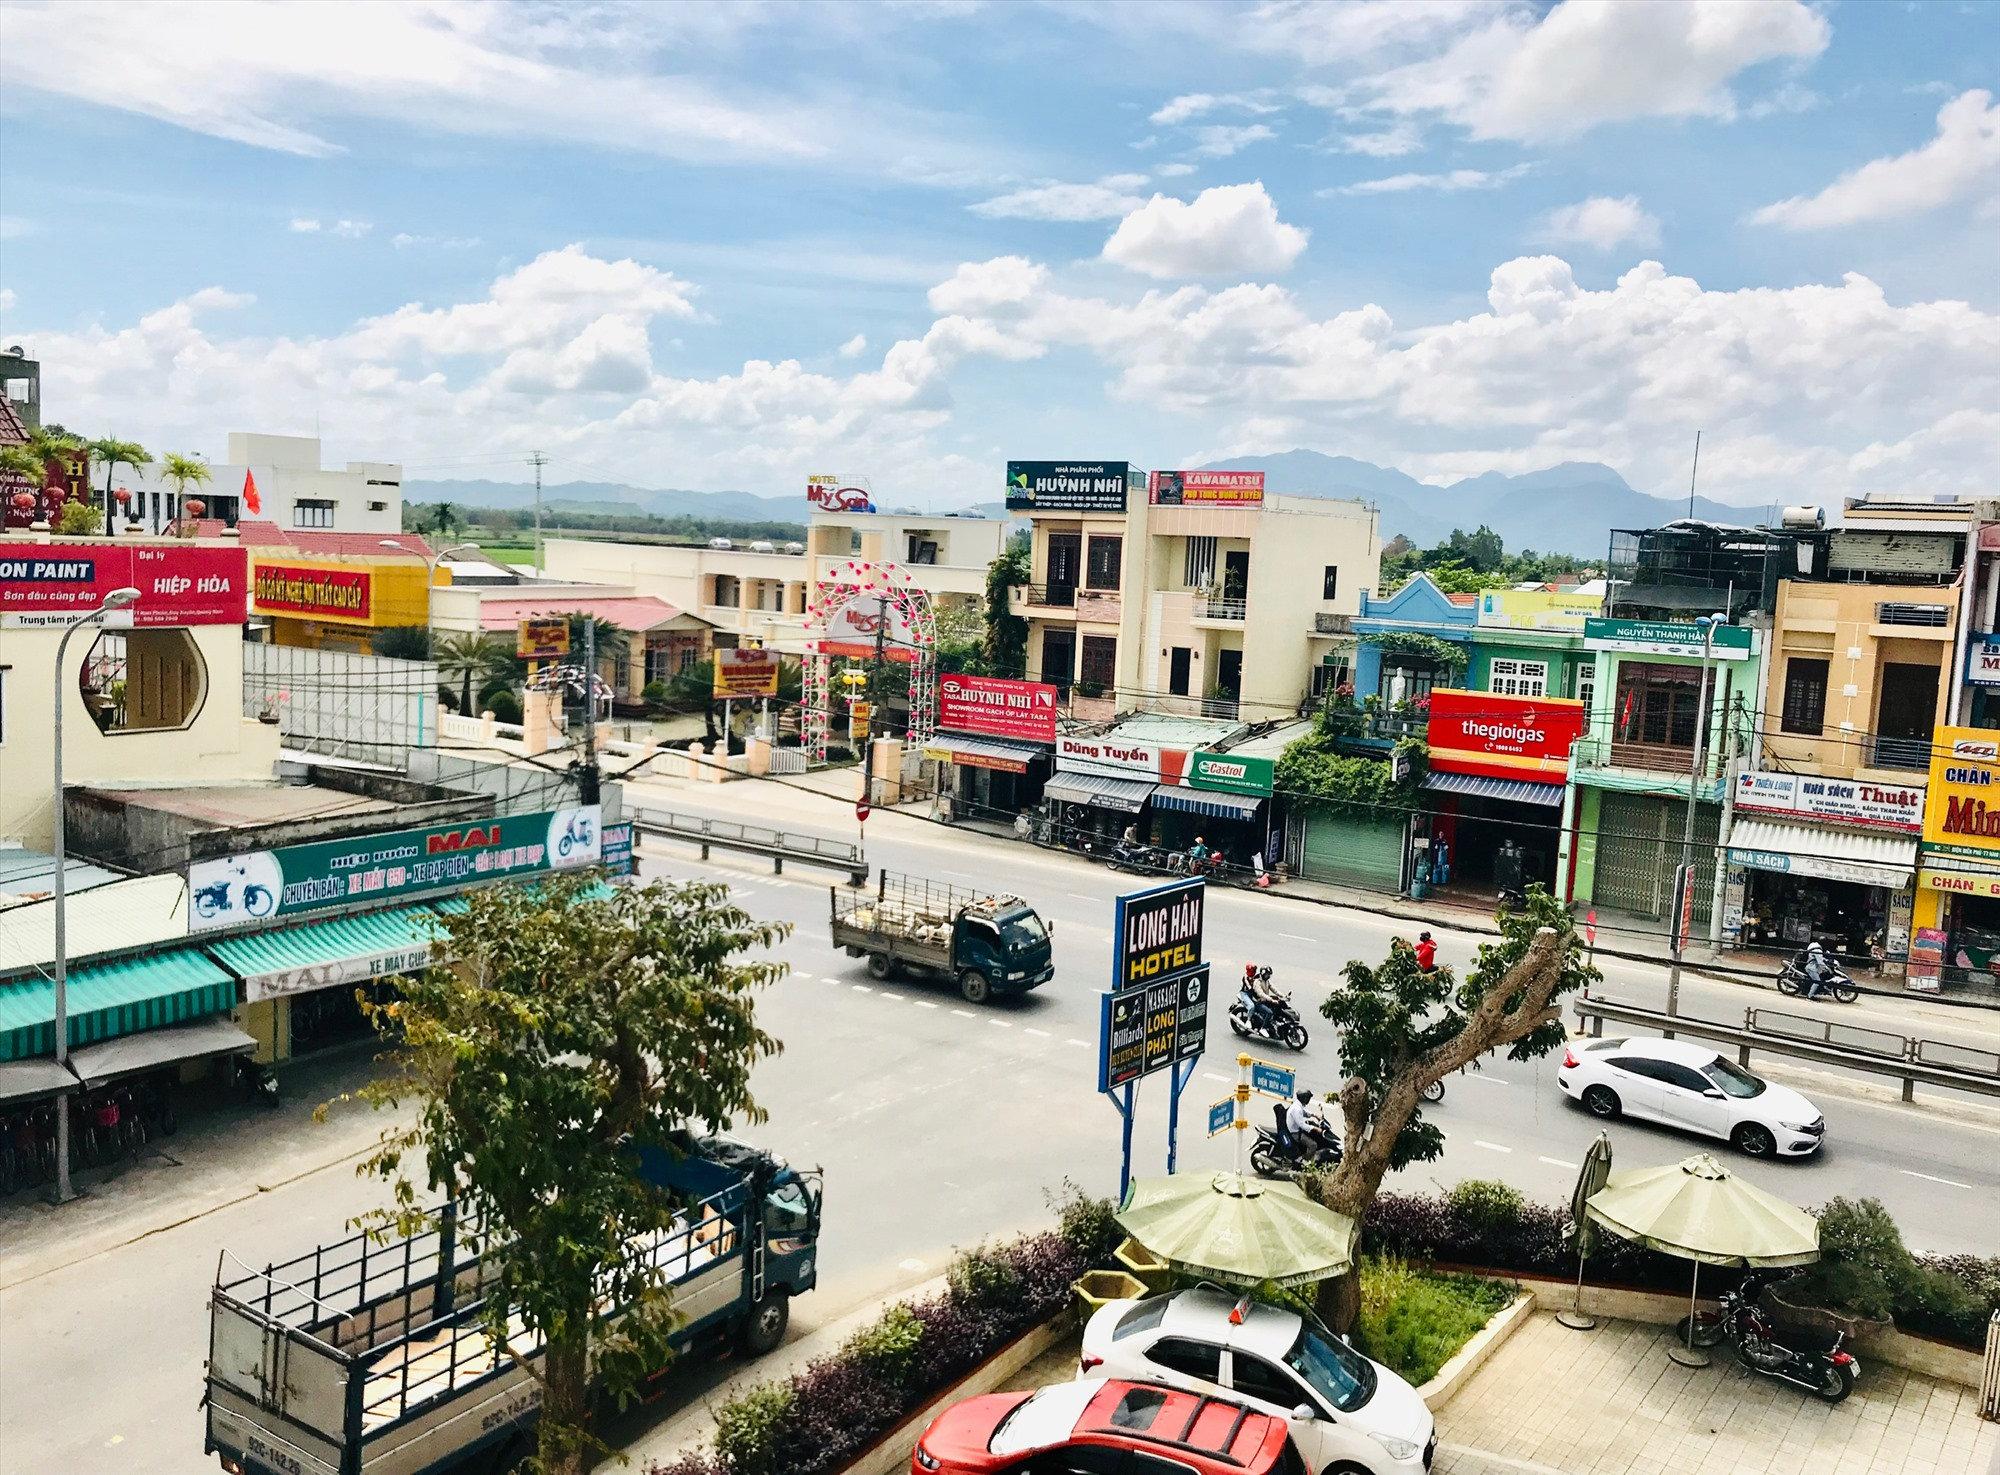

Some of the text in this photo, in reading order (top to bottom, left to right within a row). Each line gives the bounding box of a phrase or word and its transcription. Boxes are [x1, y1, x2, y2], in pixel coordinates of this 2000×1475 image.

[1187, 475, 1260, 485] KAWAMATSU
[33, 562, 91, 579] PAINT
[153, 574, 192, 596] HIỆP
[19, 616, 45, 625] Trung
[1655, 630, 1687, 640] THANH
[947, 703, 985, 714] SHOWROOM
[960, 686, 1032, 709] HUỲNH NHÌ
[1461, 719, 1545, 743] thegioigas
[1210, 763, 1243, 777] Castrol
[1803, 782, 1826, 796] NHÀ
[1827, 784, 1854, 799] SÁCH
[1859, 786, 1919, 809] Thuật
[1862, 804, 1878, 812] SÁCH
[426, 824, 501, 855] MAI
[1732, 849, 1785, 868] NHÀ SÁCH
[284, 876, 319, 906] CHUYÊN
[320, 874, 345, 900] BÁN:
[348, 872, 363, 895] XE
[412, 862, 427, 884] XE
[427, 860, 447, 884] ĐẠP
[447, 854, 469, 880] ĐIỆN
[1129, 893, 1200, 954] LONG HÂN
[369, 959, 382, 976] XE
[408, 950, 427, 968] CUP
[1130, 943, 1196, 980] HOTEL
[1147, 983, 1177, 1013] MASSAGE
[1147, 1009, 1175, 1034] LONG
[1113, 1022, 1144, 1049] Billiards
[1146, 1030, 1174, 1058] PHÁT
